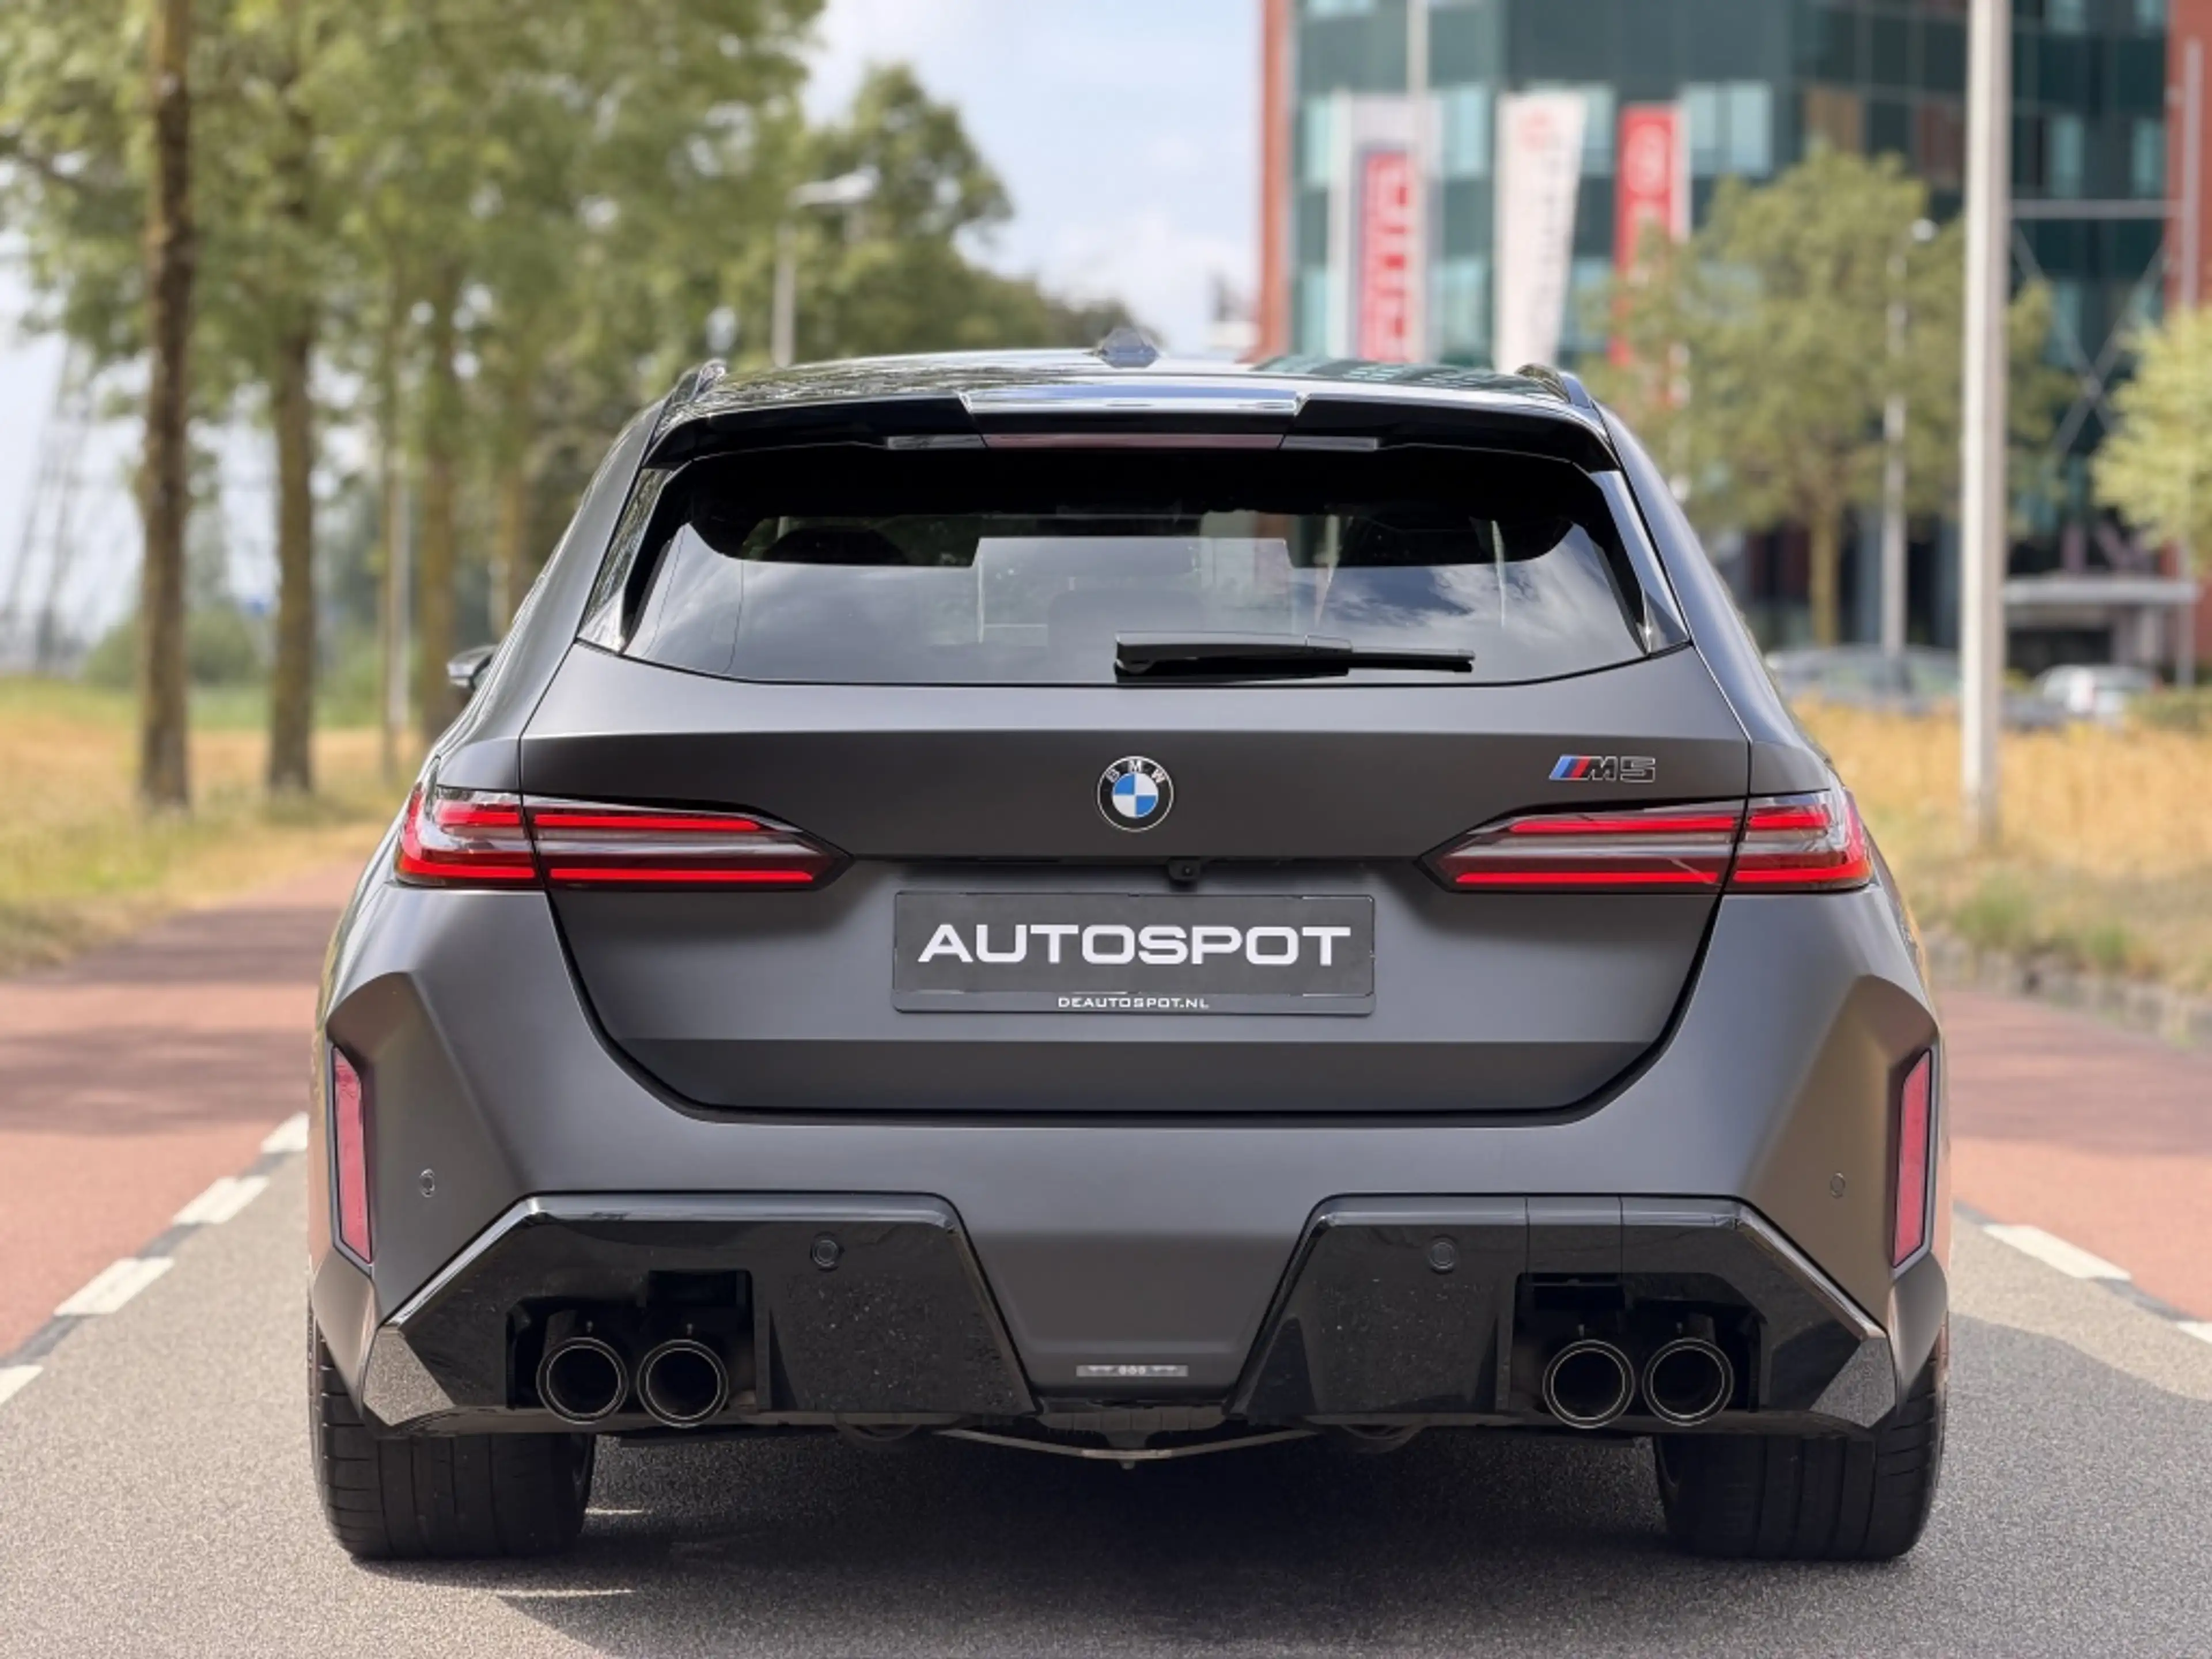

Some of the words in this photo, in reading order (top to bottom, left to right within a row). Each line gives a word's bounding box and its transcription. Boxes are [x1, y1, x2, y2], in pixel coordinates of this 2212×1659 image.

[1105, 759, 1166, 783] BMW
[1571, 755, 1656, 783] M5
[918, 924, 1351, 965] AUTOSPOT
[1058, 997, 1210, 1009] DEAUTOSPOT.NL
